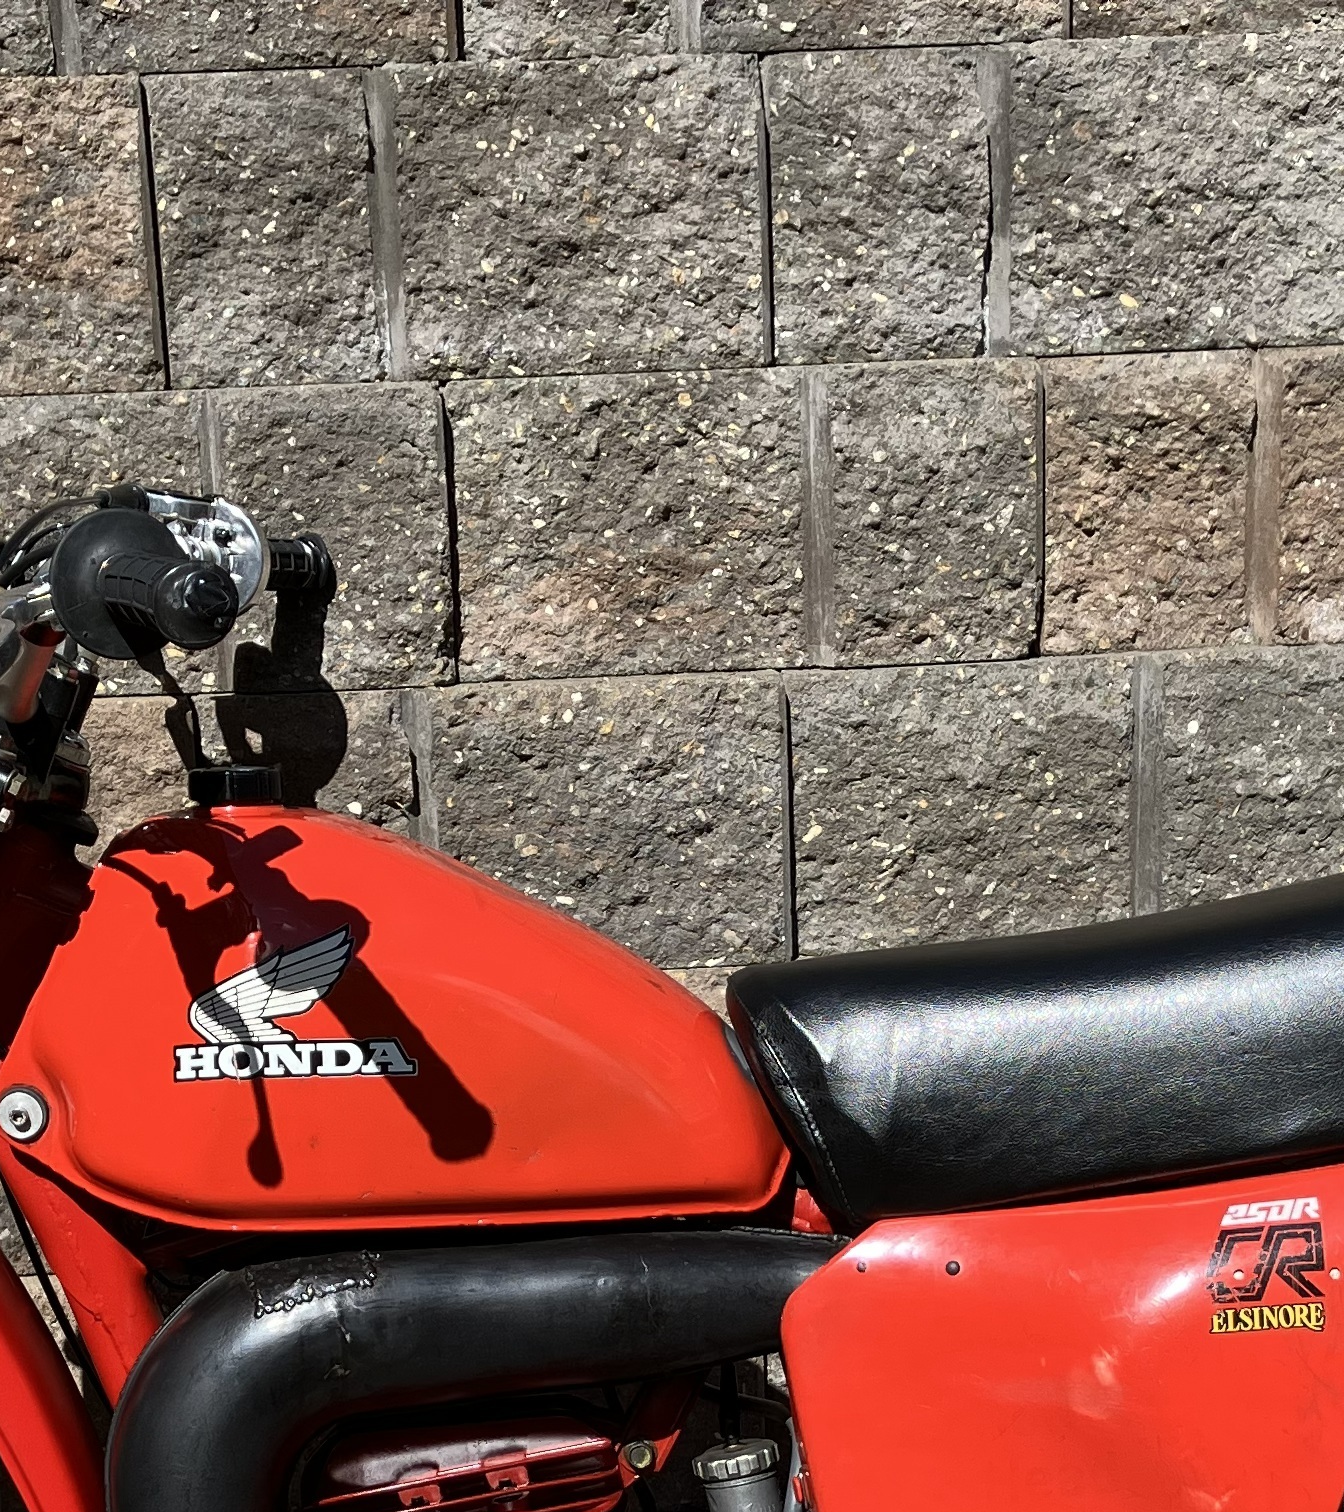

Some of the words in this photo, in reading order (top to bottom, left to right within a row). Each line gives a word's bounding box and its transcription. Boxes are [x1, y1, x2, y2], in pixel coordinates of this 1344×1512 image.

[174, 1040, 415, 1081] HONDA
[1220, 1197, 1320, 1226] 250R
[1206, 1222, 1325, 1304] CR
[1210, 1303, 1325, 1334] ELSINORE
